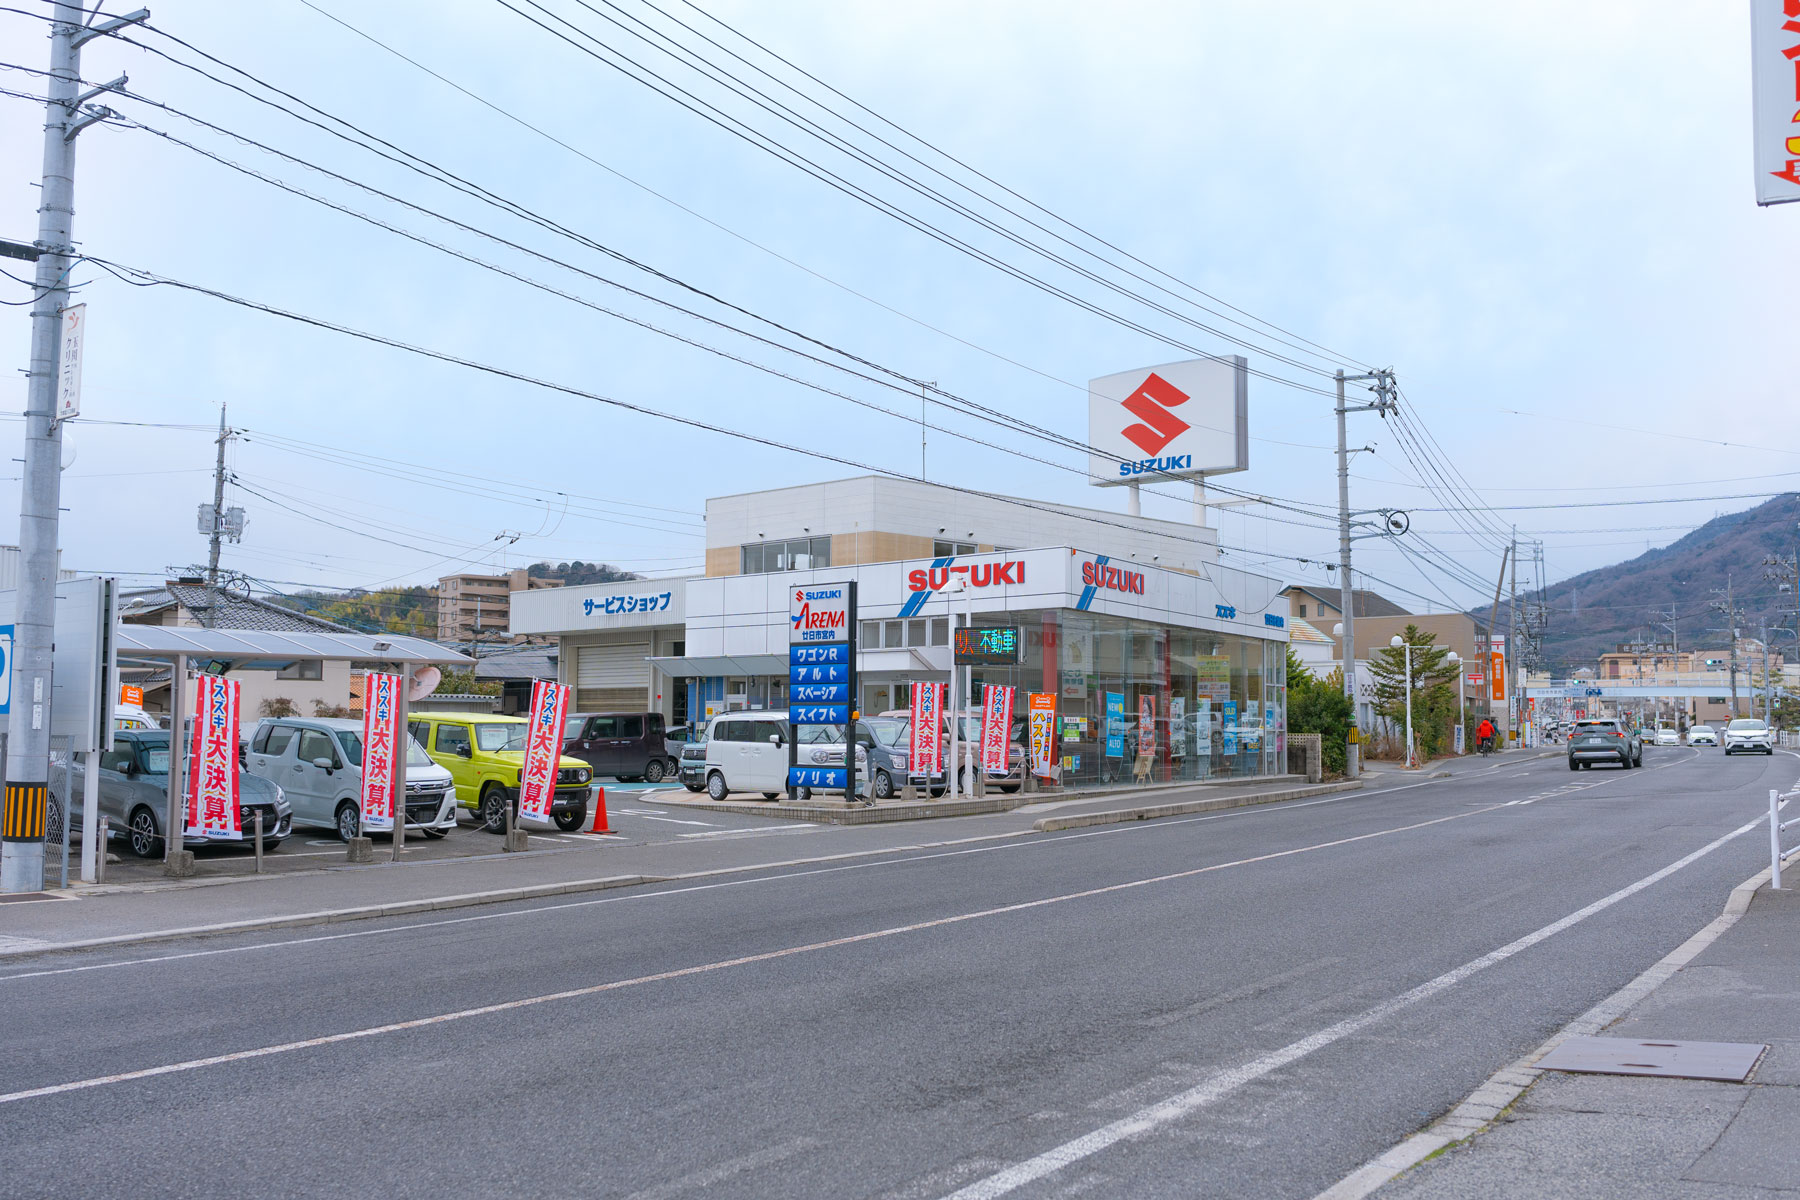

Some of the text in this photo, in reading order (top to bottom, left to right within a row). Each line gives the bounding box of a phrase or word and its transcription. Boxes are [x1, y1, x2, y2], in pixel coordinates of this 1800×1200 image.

[63, 338, 72, 399] クリニック
[1119, 454, 1191, 476] SUZUKI
[1082, 561, 1145, 595] SUZUKI
[805, 590, 842, 600] SUZUKI
[583, 592, 671, 616] サービスショップ
[791, 602, 845, 630] ARENA
[801, 630, 835, 640] 廿日市宮内
[797, 647, 838, 662] ワゴンR
[797, 666, 837, 681] アルト
[797, 686, 838, 700] スペーシア
[797, 707, 837, 721] スイフト
[1107, 704, 1119, 712] NEW
[1032, 713, 1046, 768] ハスラー
[1108, 740, 1121, 748] ALTO
[796, 771, 836, 785] ソリオ
